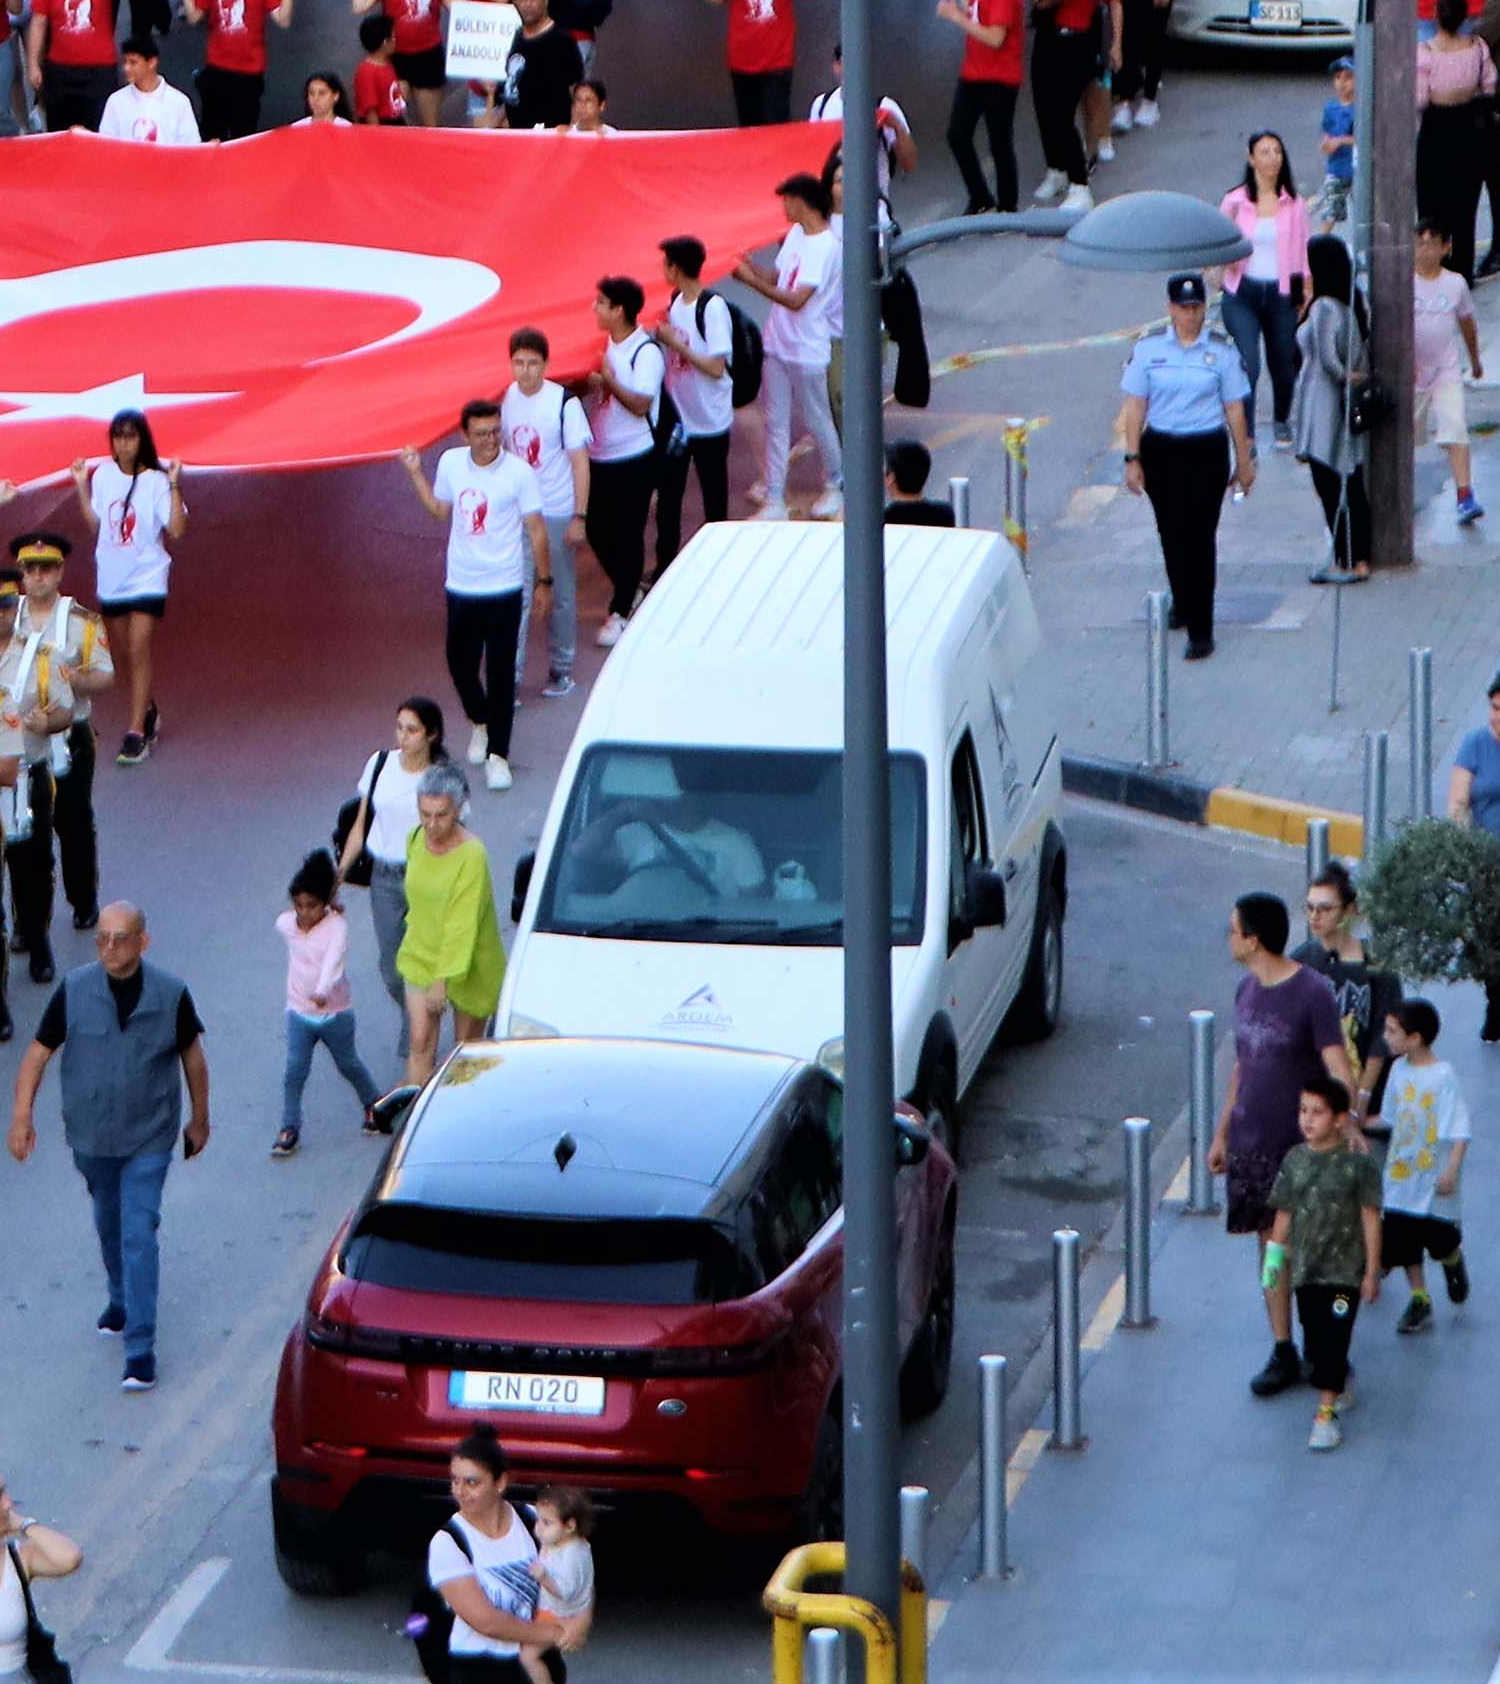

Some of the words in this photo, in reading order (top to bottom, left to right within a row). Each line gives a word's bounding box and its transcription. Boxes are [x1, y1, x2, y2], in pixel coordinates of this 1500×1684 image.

[450, 43, 502, 61] ANADOLU
[486, 1376, 522, 1401] RN
[528, 1377, 580, 1404] 020
